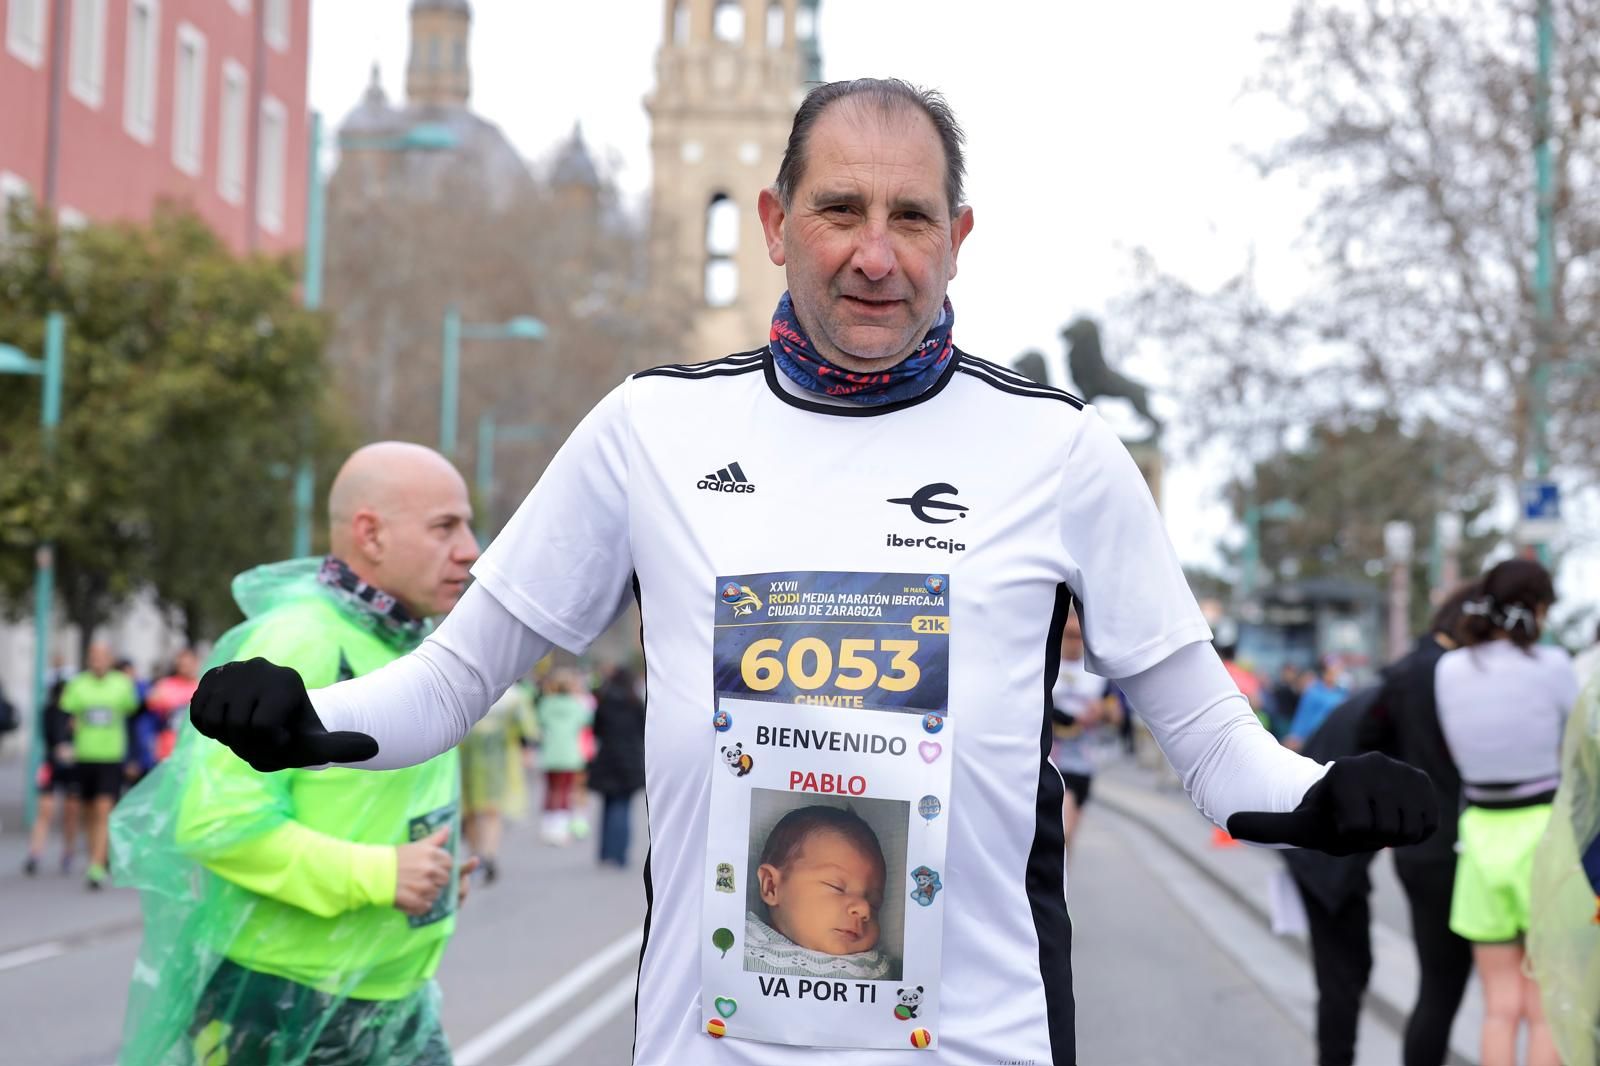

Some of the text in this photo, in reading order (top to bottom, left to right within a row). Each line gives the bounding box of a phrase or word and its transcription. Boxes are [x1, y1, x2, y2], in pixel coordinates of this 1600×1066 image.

[696, 479, 756, 494] adidas
[886, 533, 967, 554] iberCaja
[769, 581, 798, 592] XXVII
[768, 592, 945, 607] RODI MEDIA MARATÓN IBERCAJA
[767, 604, 882, 617] CIUDAD DE ZARAGOZA
[918, 618, 945, 632] 21k
[740, 636, 921, 692] 6053
[794, 694, 864, 708] CHIVITE
[755, 725, 907, 756] BIENVENIDO
[789, 770, 867, 796] PABLO
[758, 975, 876, 1003] VA POR TI
